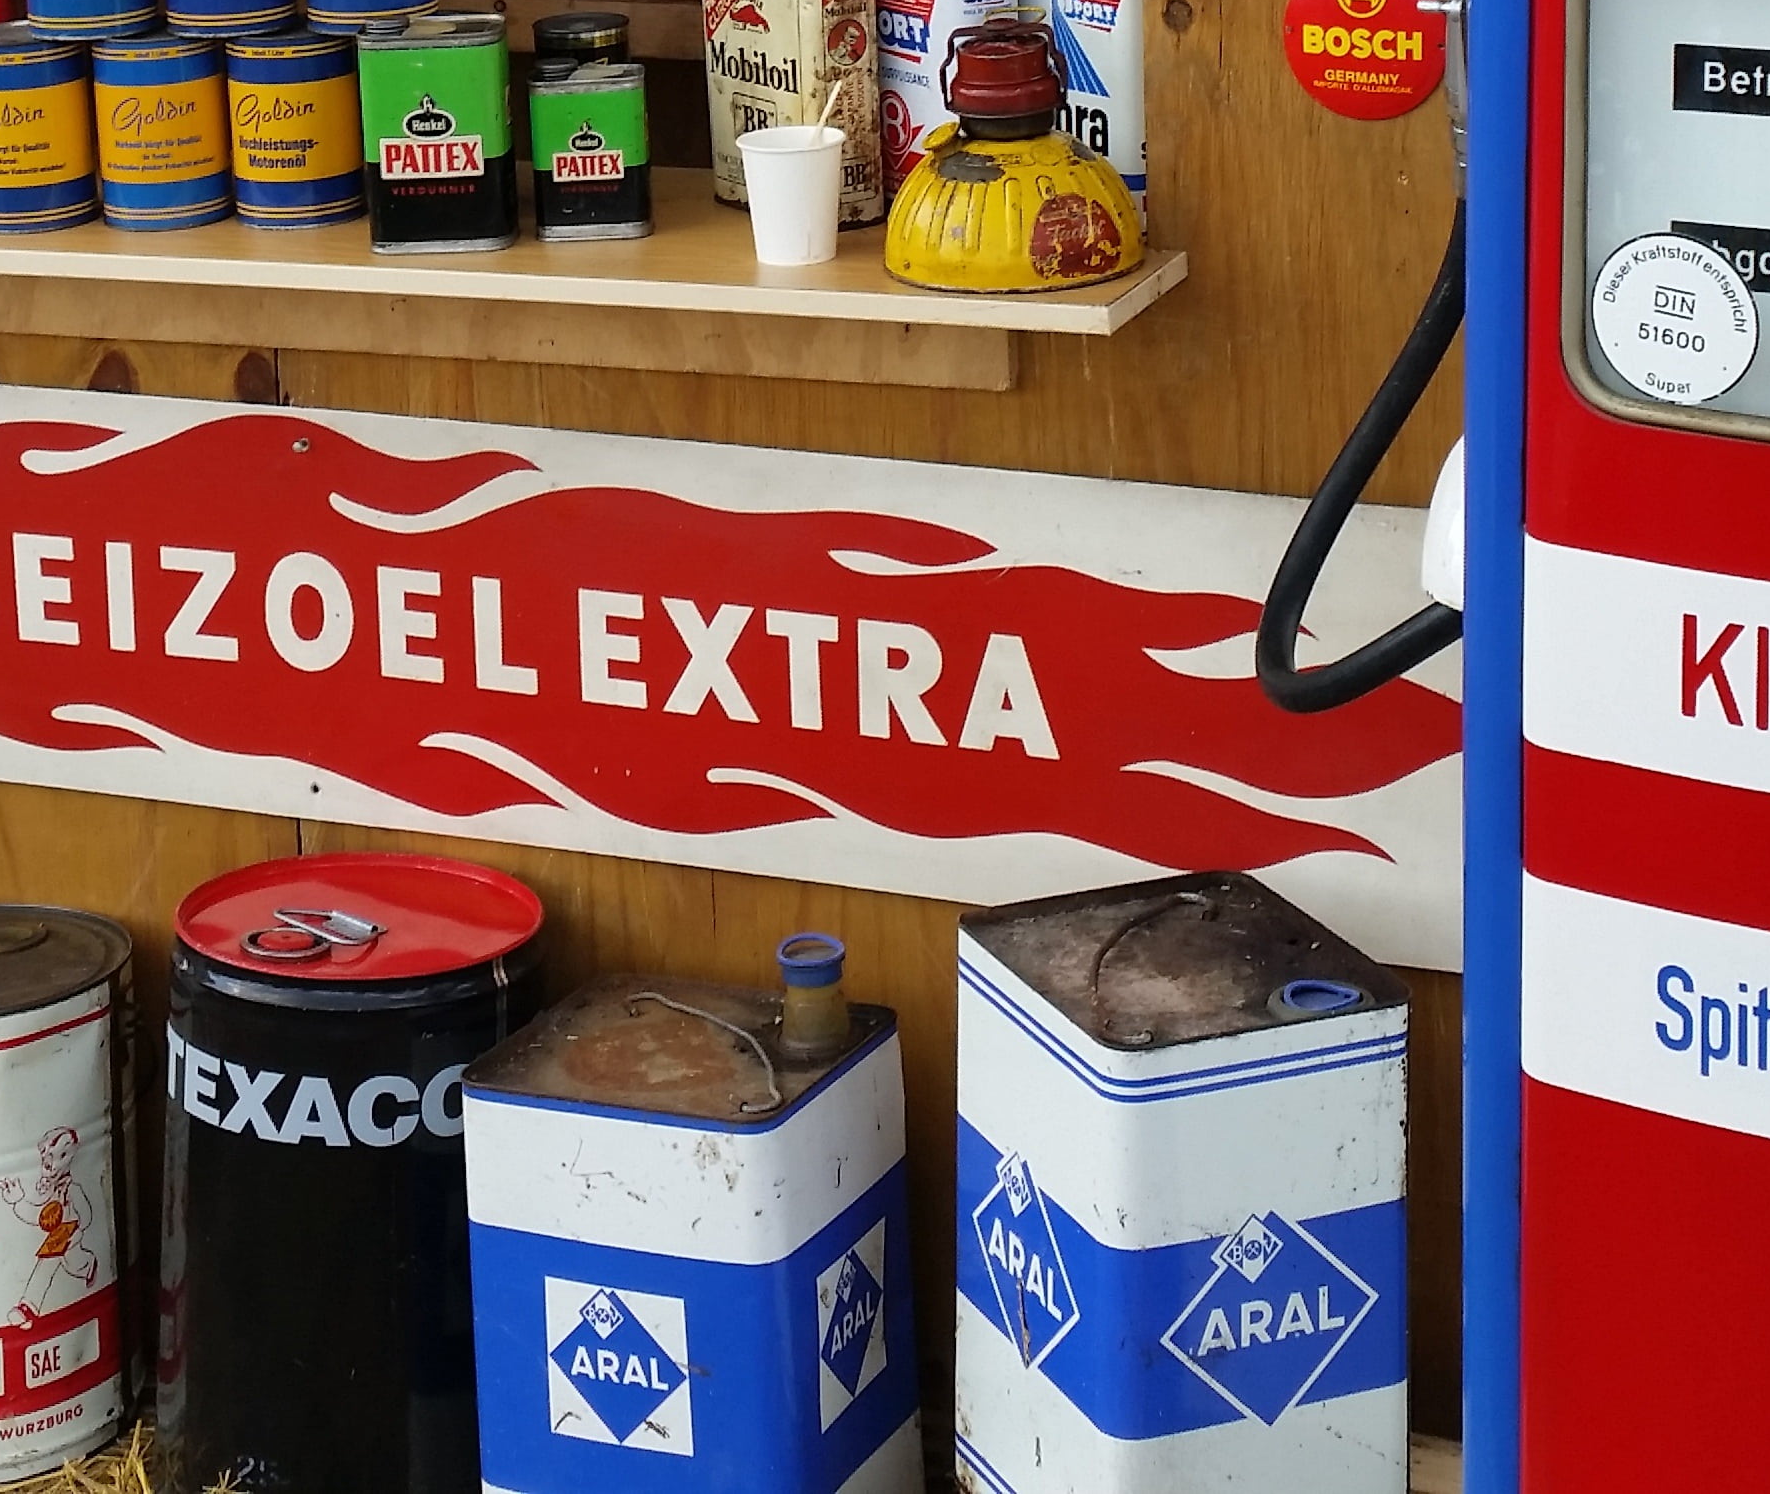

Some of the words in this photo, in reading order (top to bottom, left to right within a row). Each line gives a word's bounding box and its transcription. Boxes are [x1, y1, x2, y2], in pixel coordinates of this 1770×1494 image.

[1302, 24, 1423, 61] BOSCH
[709, 39, 799, 94] Mobiloil
[1324, 69, 1400, 85] GERMANY
[411, 117, 446, 132] Henkel
[384, 140, 480, 175] PATTEX
[556, 154, 622, 178] PATTEX
[1603, 260, 1632, 304] Dieser
[1631, 245, 1704, 266] Kraftstoff
[1703, 259, 1748, 334] entspricht
[1654, 290, 1696, 315] DIN
[1638, 323, 1706, 353] 51600
[1645, 372, 1691, 394] Super
[577, 586, 1062, 762] EXTRA
[165, 1017, 467, 1148] TEXACO
[988, 1216, 1063, 1323] ARAL
[829, 1297, 875, 1360] ARAL
[1196, 1285, 1347, 1358] ARAL
[30, 1344, 61, 1380] SAE
[570, 1344, 669, 1392] ARAL
